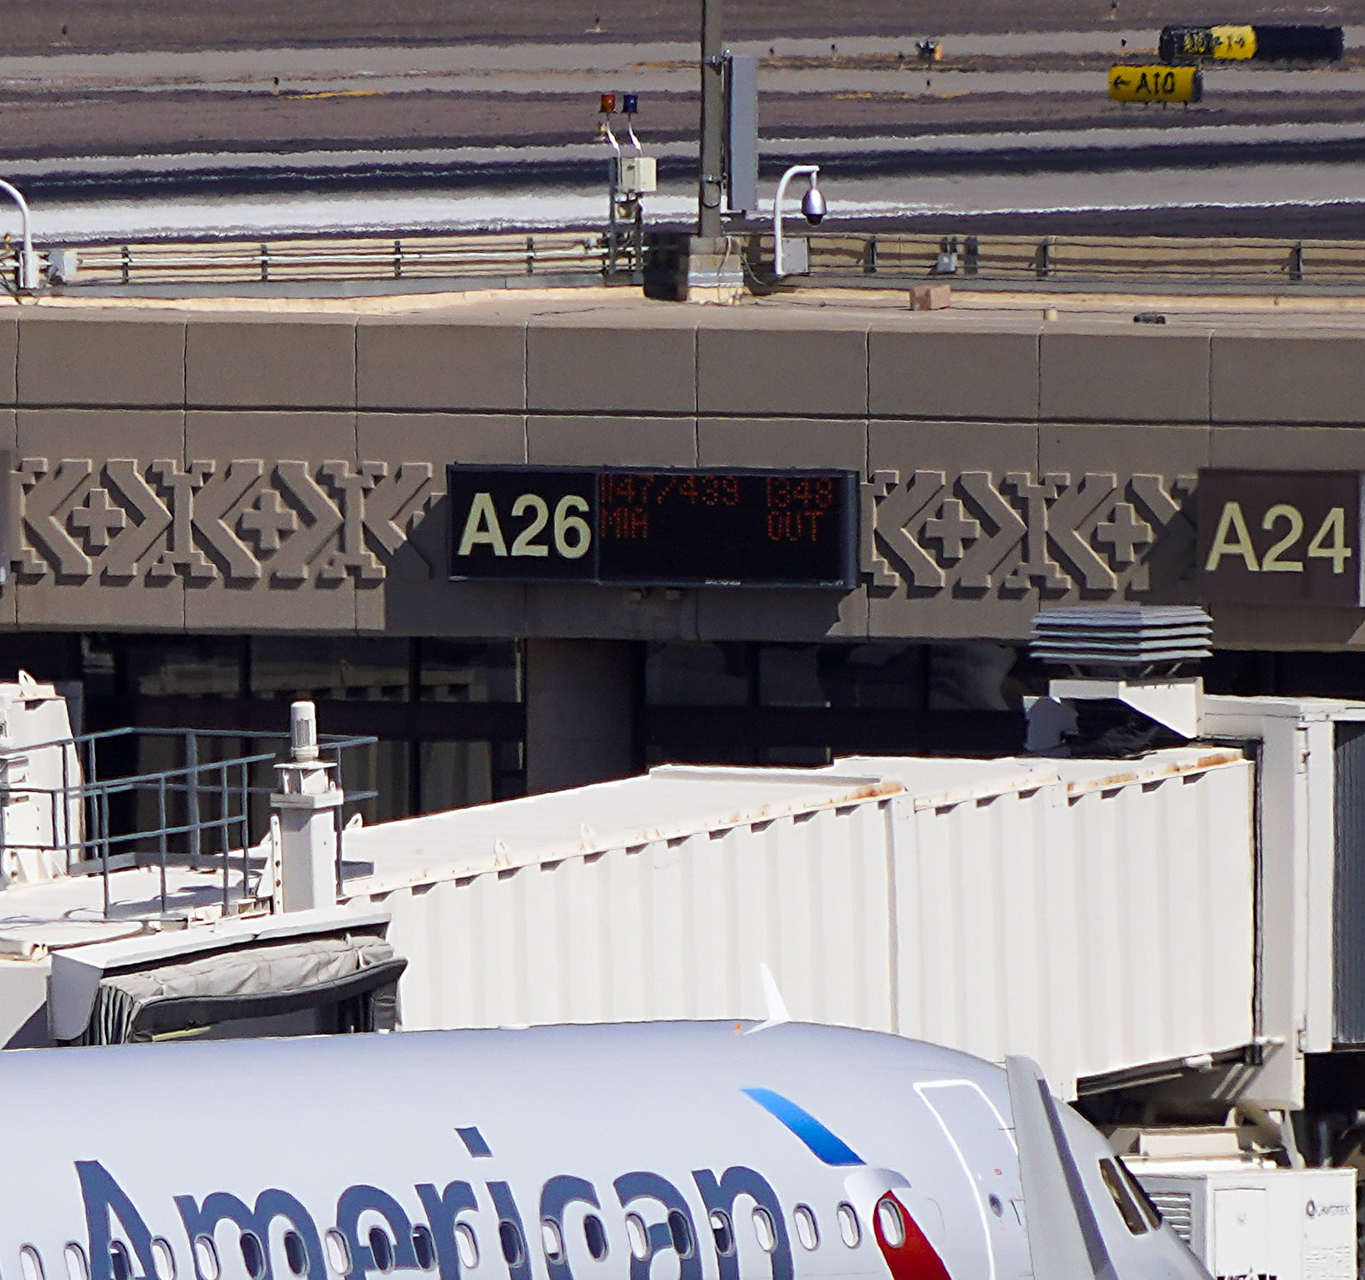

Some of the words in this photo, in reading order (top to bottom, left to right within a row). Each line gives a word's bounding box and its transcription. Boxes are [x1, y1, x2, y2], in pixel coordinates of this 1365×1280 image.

[1135, 71, 1176, 95] A10
[767, 476, 834, 508] 1348
[457, 491, 592, 559] A26
[600, 507, 650, 538] MIA
[768, 510, 824, 541] OUT
[1204, 500, 1353, 574] A24
